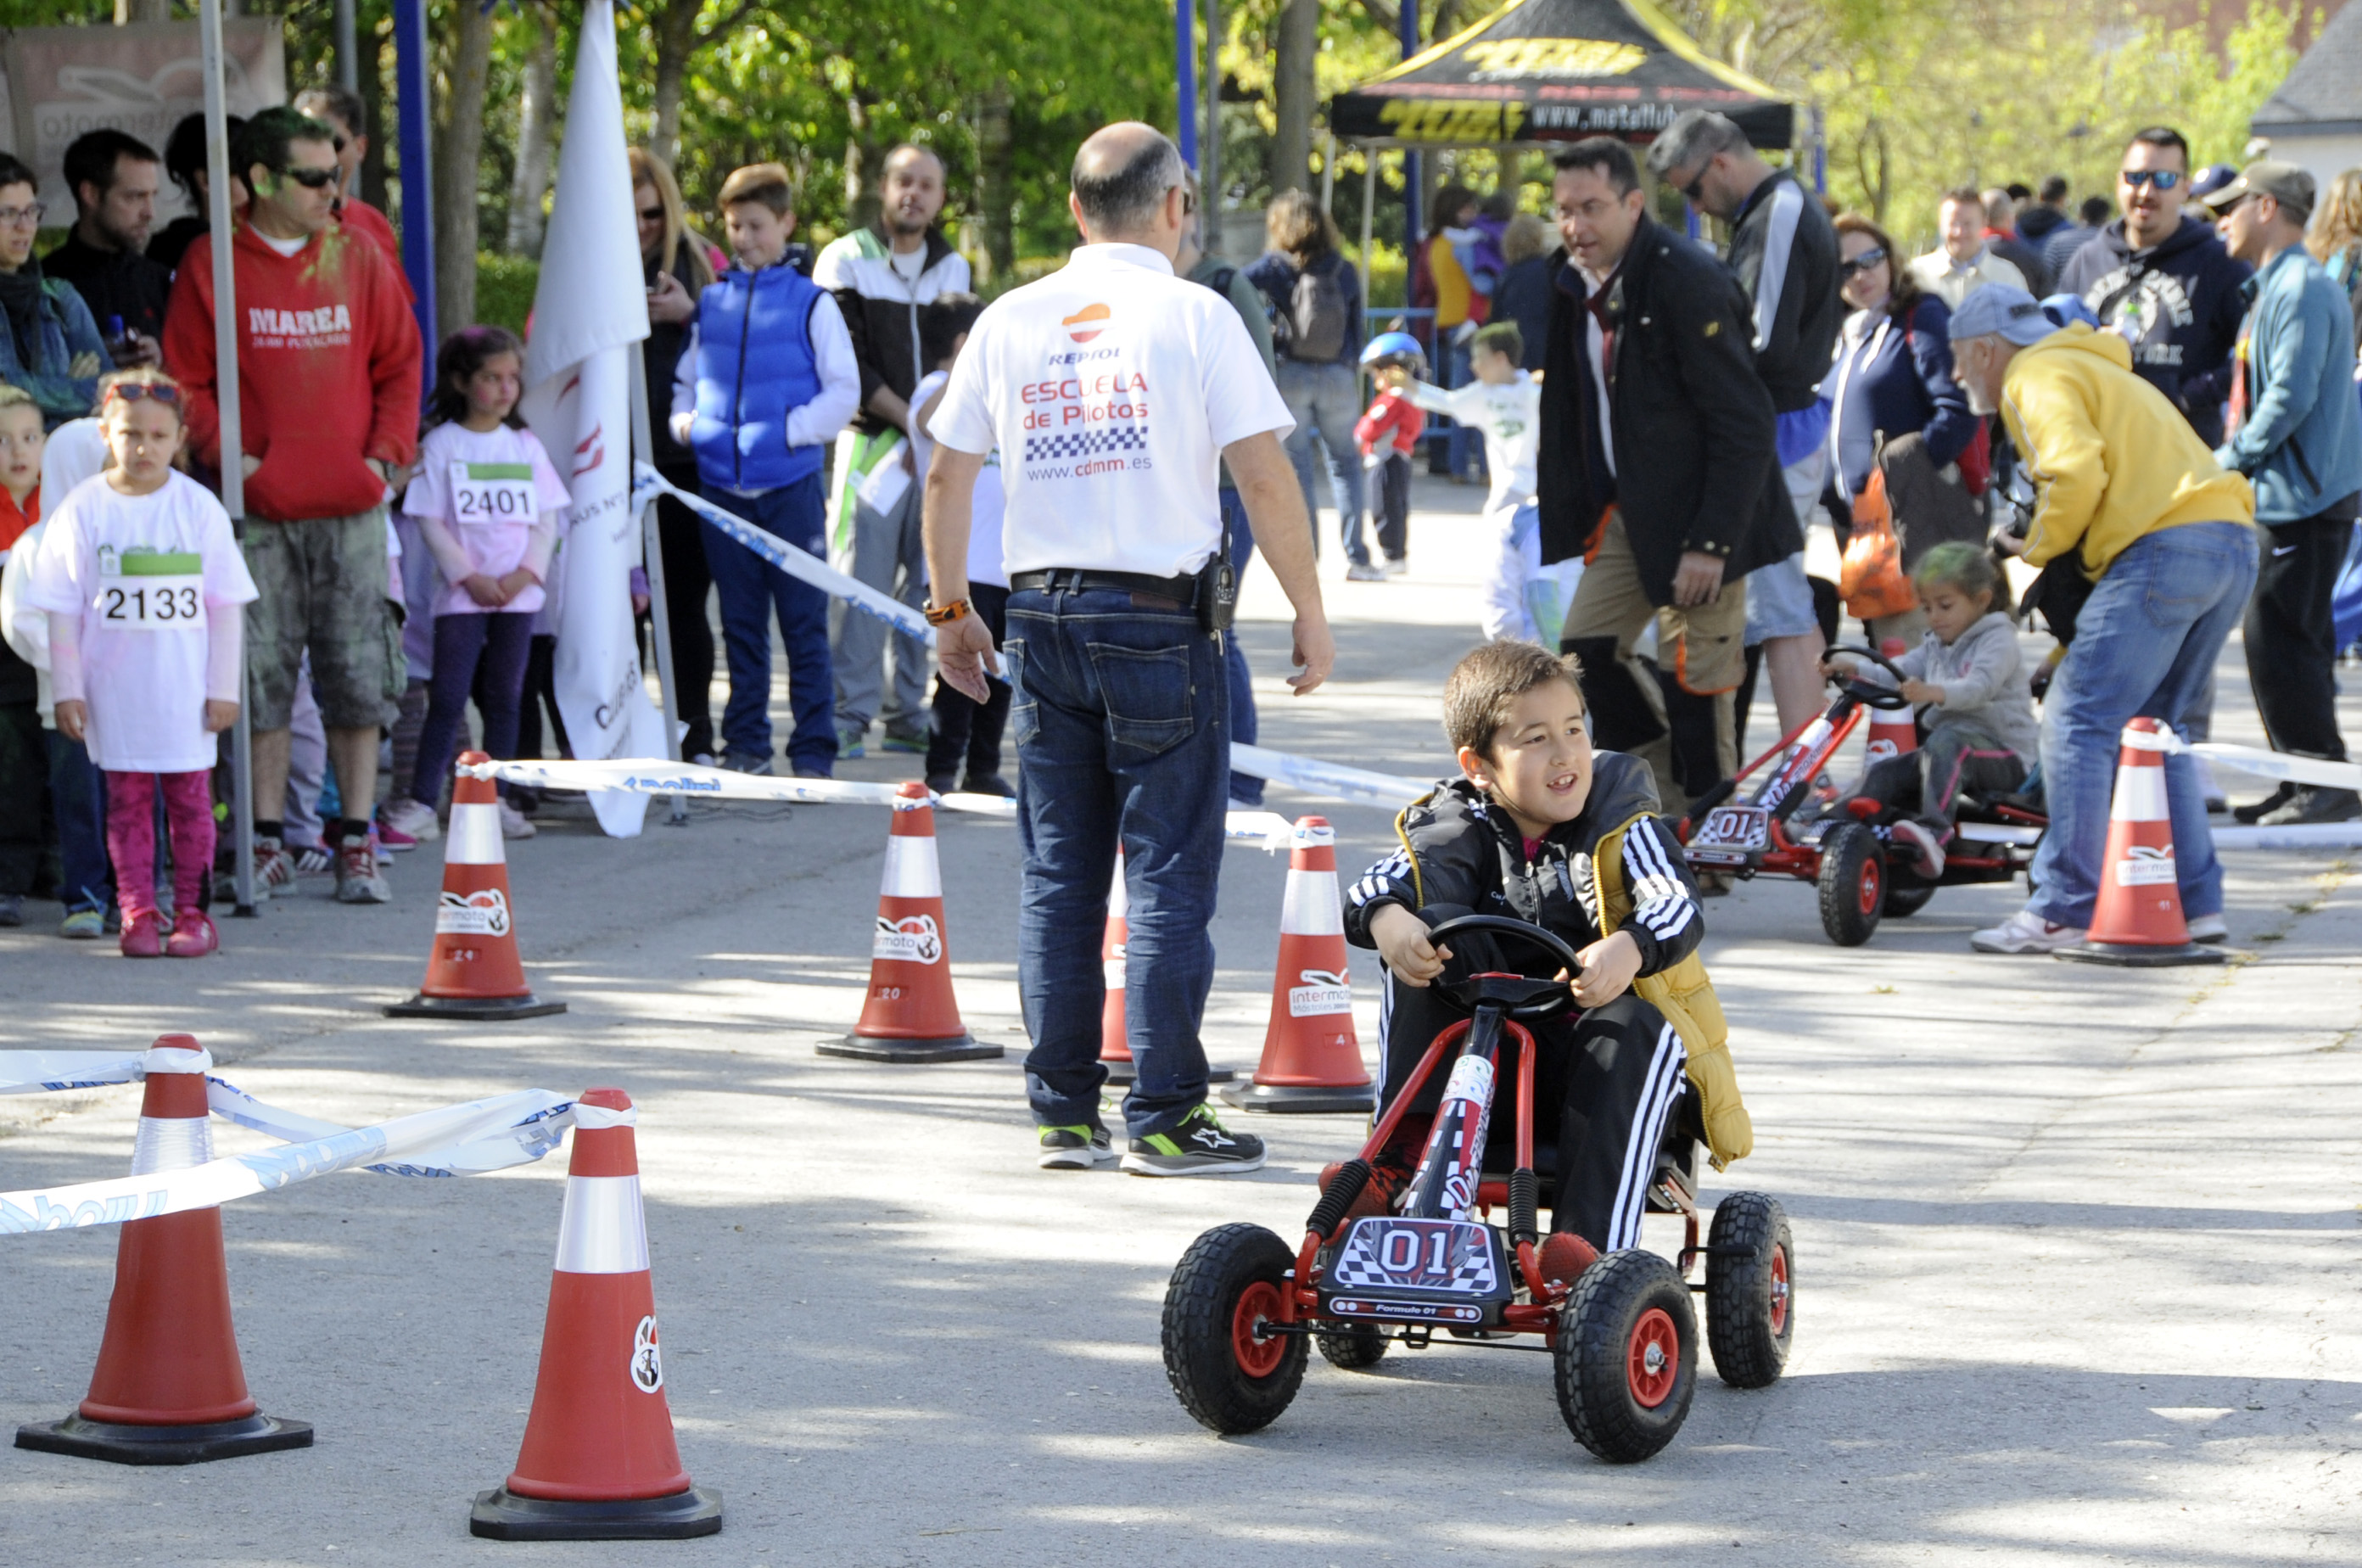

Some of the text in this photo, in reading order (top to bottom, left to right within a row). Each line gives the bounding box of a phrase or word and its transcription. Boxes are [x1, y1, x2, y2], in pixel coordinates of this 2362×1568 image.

[249, 305, 351, 336] MAREA
[1049, 348, 1120, 366] REPSOL
[1021, 372, 1149, 404] ESCUELA
[1023, 400, 1148, 430] de Pilotos
[1027, 456, 1152, 481] www.cdmm.es
[459, 489, 529, 514] 2401
[106, 588, 197, 619] 2133
[1717, 812, 1750, 839] 01
[882, 987, 901, 1000] 20
[1380, 1229, 1447, 1274] 01
[1375, 1304, 1421, 1314] Formule
